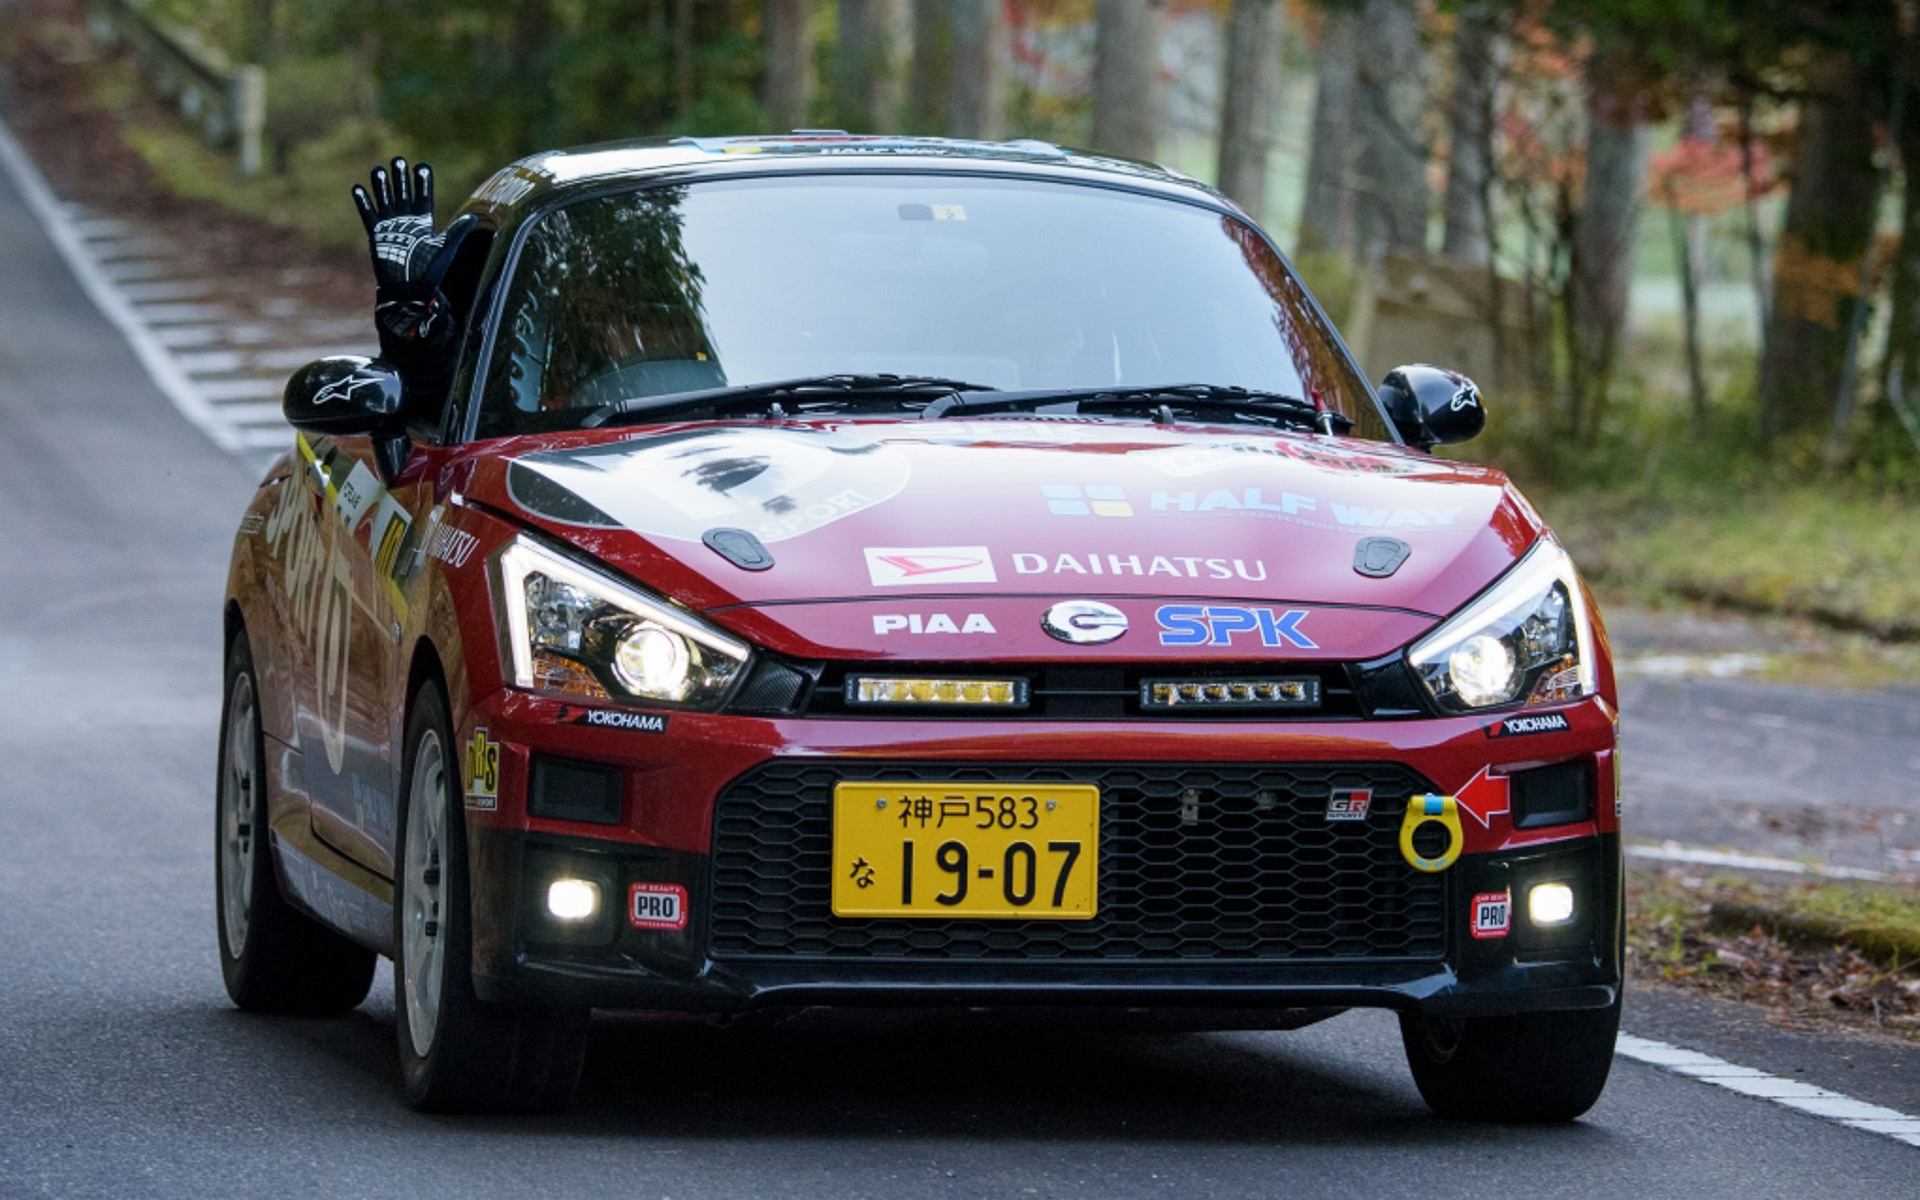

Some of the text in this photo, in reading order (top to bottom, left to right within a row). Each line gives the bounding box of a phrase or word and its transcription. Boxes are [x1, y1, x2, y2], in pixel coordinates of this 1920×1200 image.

[761, 488, 871, 539] SPORT
[1149, 487, 1465, 528] HALF WAY
[1012, 553, 1268, 582] DAIHATSU
[872, 613, 997, 635] PIAA
[1154, 604, 1320, 649] SPK
[588, 709, 663, 731] YOKOHAMA
[1503, 715, 1567, 733] YOKOHAMA
[1331, 799, 1366, 812] GR
[850, 840, 1081, 907] な 19-07
[638, 896, 673, 918] PRO
[1481, 904, 1505, 927] PRO
